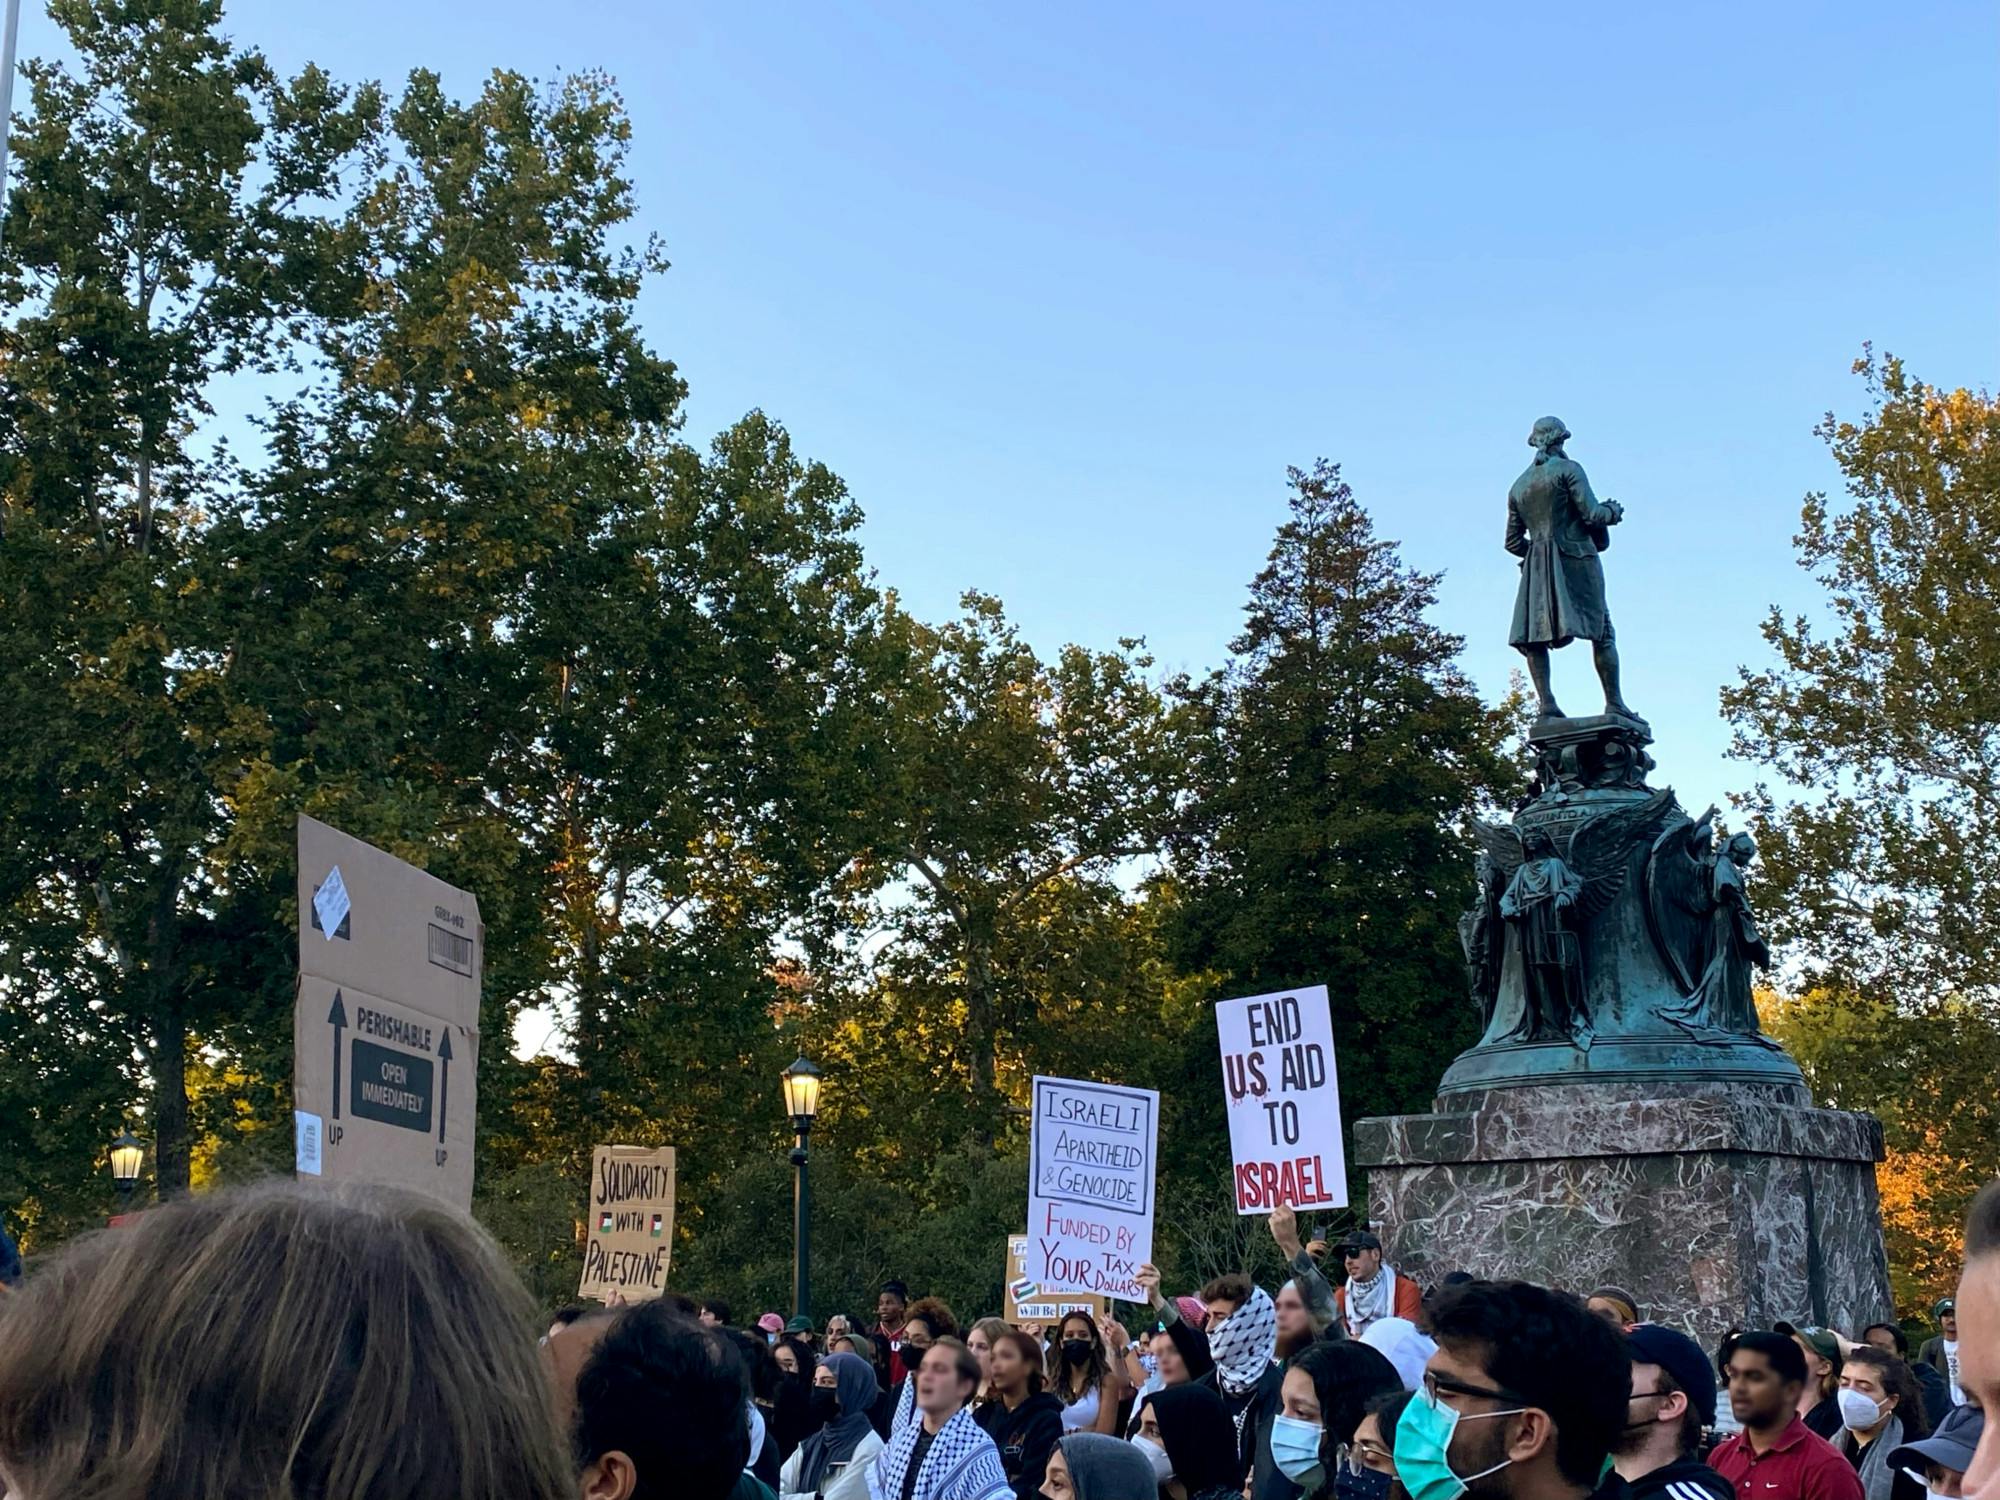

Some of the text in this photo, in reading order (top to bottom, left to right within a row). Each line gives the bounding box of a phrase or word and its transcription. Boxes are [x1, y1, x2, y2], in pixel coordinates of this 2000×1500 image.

[357, 1007, 432, 1051] PERISHABLE
[1247, 996, 1302, 1048] END
[381, 1062, 408, 1086] OPEN
[1225, 1043, 1326, 1100] U.S. AID
[362, 1080, 425, 1113] IMMEDIATELY
[1044, 1091, 1142, 1131] ISRAELI
[329, 1124, 343, 1147] UP
[1263, 1100, 1300, 1146] TO
[435, 1149, 448, 1168] UP
[1053, 1129, 1143, 1168] APARTHEID
[596, 1156, 669, 1206] SOLIDARITY
[1042, 1166, 1137, 1202] & GENOCIDE
[1235, 1155, 1333, 1210] ISRAEL
[616, 1211, 644, 1232] WITH
[1046, 1203, 1137, 1254] FUNDED BY
[583, 1239, 667, 1289] PALESTINE
[1039, 1237, 1135, 1289] YOUR TAX
[1020, 1305, 1037, 1316] Will
[1043, 1305, 1056, 1316] Be
